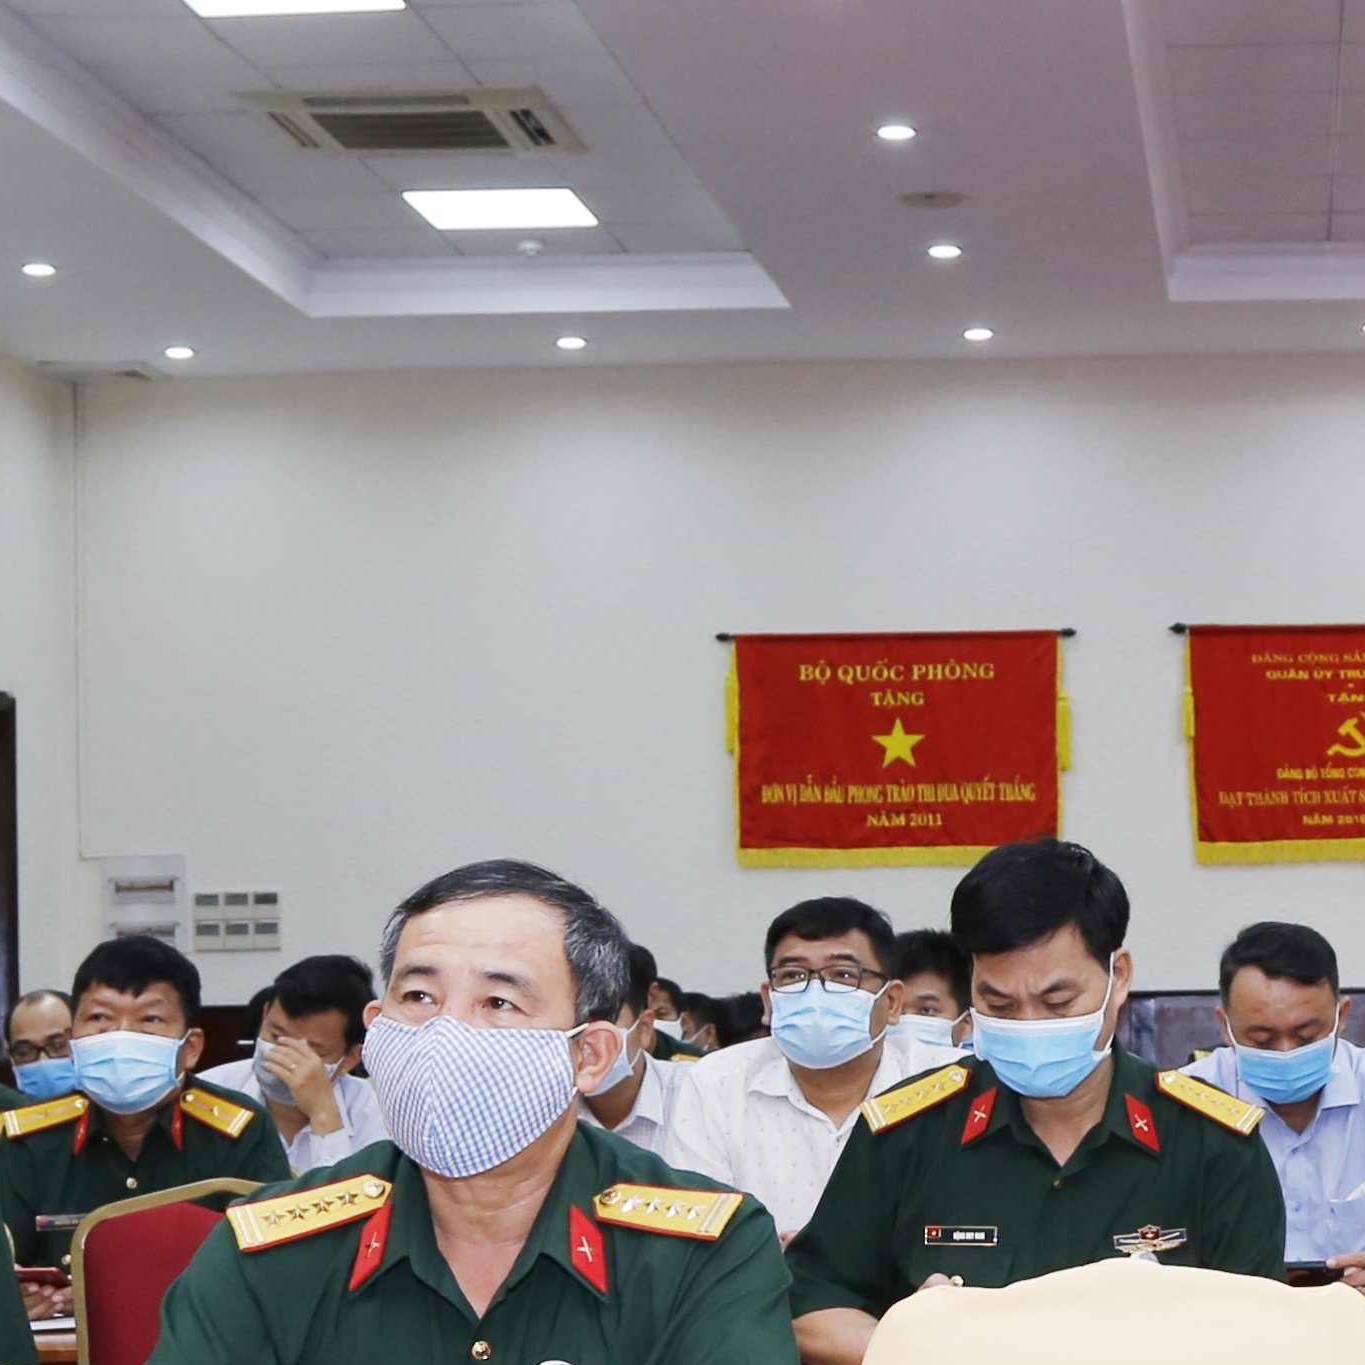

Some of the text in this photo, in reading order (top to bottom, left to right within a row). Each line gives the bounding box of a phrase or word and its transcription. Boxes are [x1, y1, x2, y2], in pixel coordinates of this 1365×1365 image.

[799, 658, 995, 685] BỘ QUỐC PHÒNG
[867, 810, 942, 827] NĂM 2011
